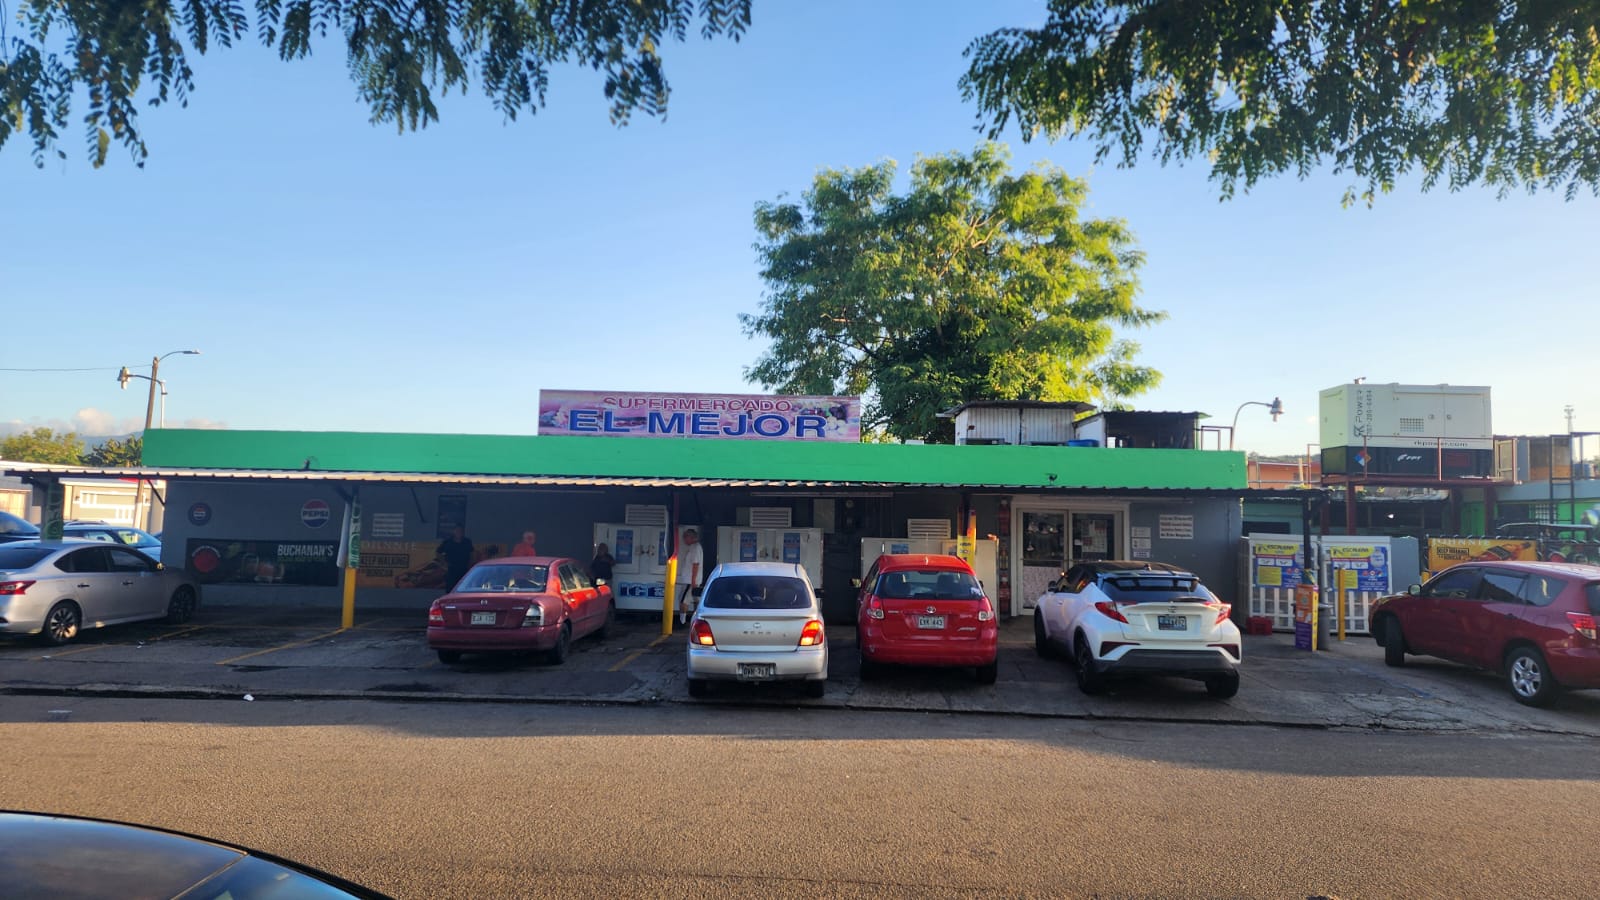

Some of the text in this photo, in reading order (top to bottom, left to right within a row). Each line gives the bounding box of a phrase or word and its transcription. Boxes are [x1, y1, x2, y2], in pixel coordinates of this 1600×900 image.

[602, 397, 792, 412] SUPERMERCADO
[568, 409, 828, 438] EL MEJOR
[303, 509, 329, 519] PEPSI
[277, 544, 334, 557] BUCHANAN'S
